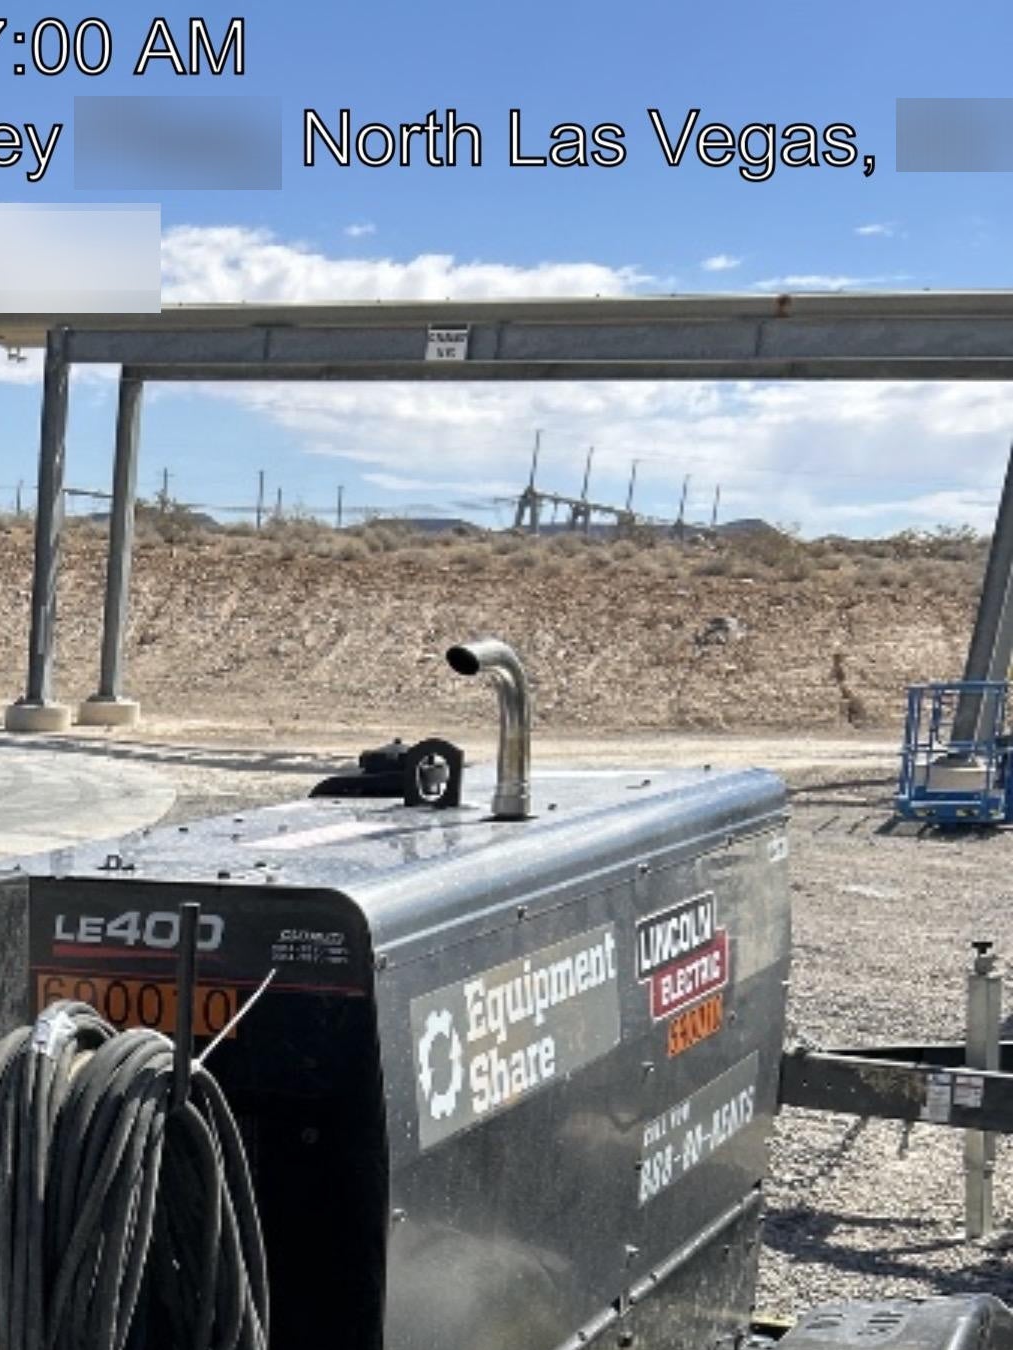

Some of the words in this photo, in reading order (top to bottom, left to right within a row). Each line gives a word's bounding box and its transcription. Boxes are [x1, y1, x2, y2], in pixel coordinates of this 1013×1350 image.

[54, 911, 225, 950] LE400
[640, 902, 712, 971] LINCOLN
[463, 931, 617, 1044] Equipment
[661, 950, 721, 1006] ELECTRIC
[469, 1033, 556, 1114] Share
